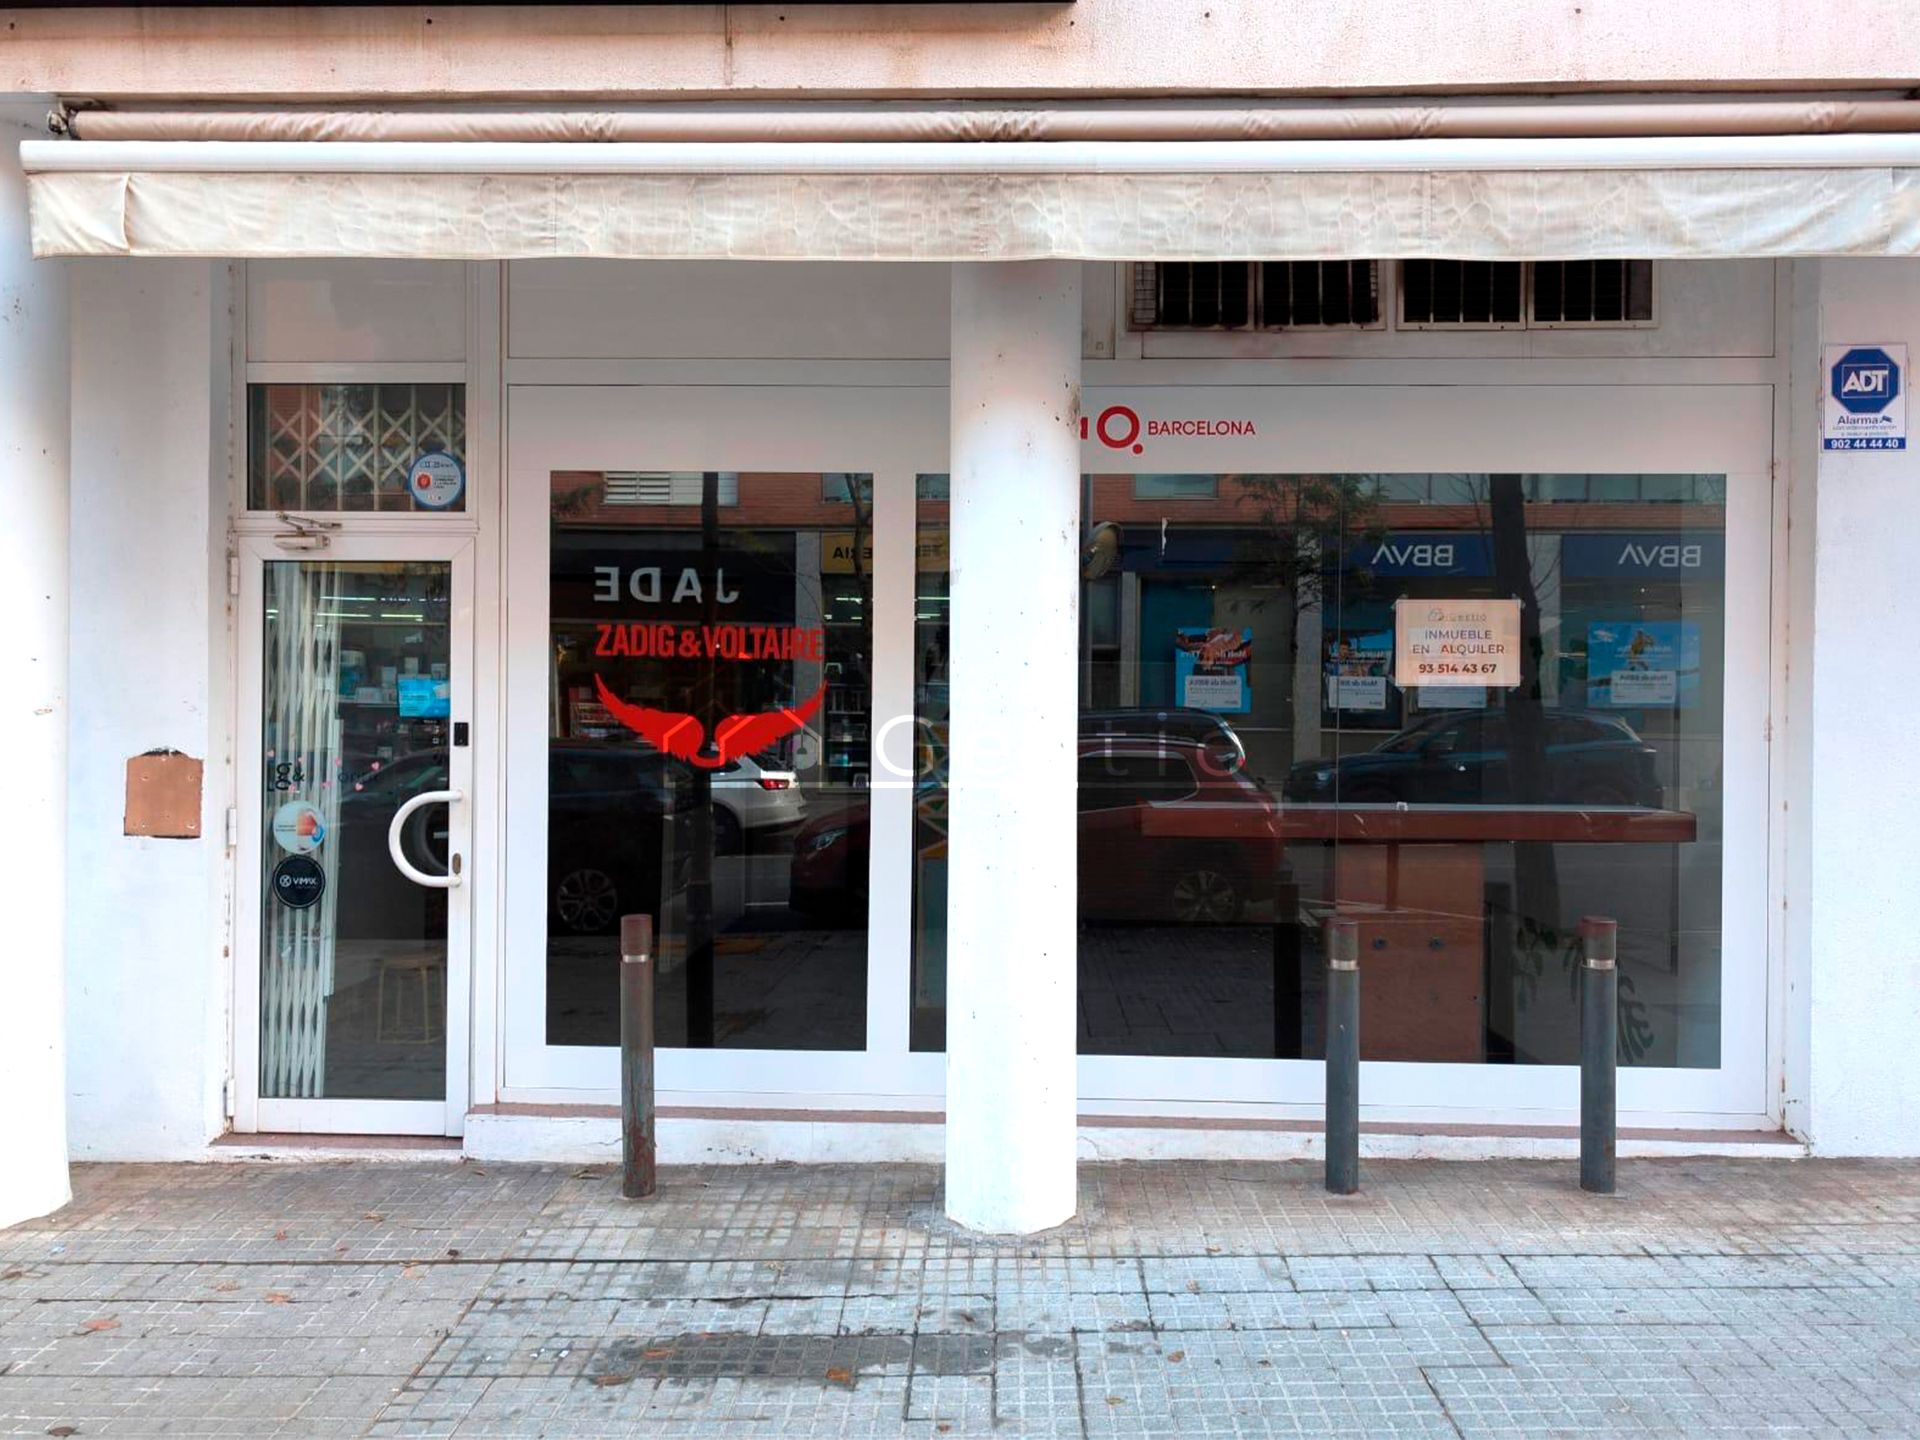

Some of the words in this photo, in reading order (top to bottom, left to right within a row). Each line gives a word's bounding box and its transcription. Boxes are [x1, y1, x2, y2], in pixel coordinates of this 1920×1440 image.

[1842, 369, 1889, 392] ADT
[1837, 415, 1879, 425] Alarma
[1147, 420, 1256, 436] BARCELONA
[1830, 439, 1852, 449] 902
[1853, 439, 1867, 448] 44
[1869, 439, 1883, 448] 44
[1885, 439, 1899, 448] 40
[1424, 629, 1493, 641] INMUEBLE
[595, 624, 826, 663] ZADIG&VOLTAIRE
[1412, 644, 1431, 655] EN
[1440, 644, 1506, 657] ALQUILER
[1418, 663, 1434, 674] 93
[1437, 663, 1459, 674] 514
[1461, 663, 1478, 674] 43
[1480, 663, 1498, 674] 67
